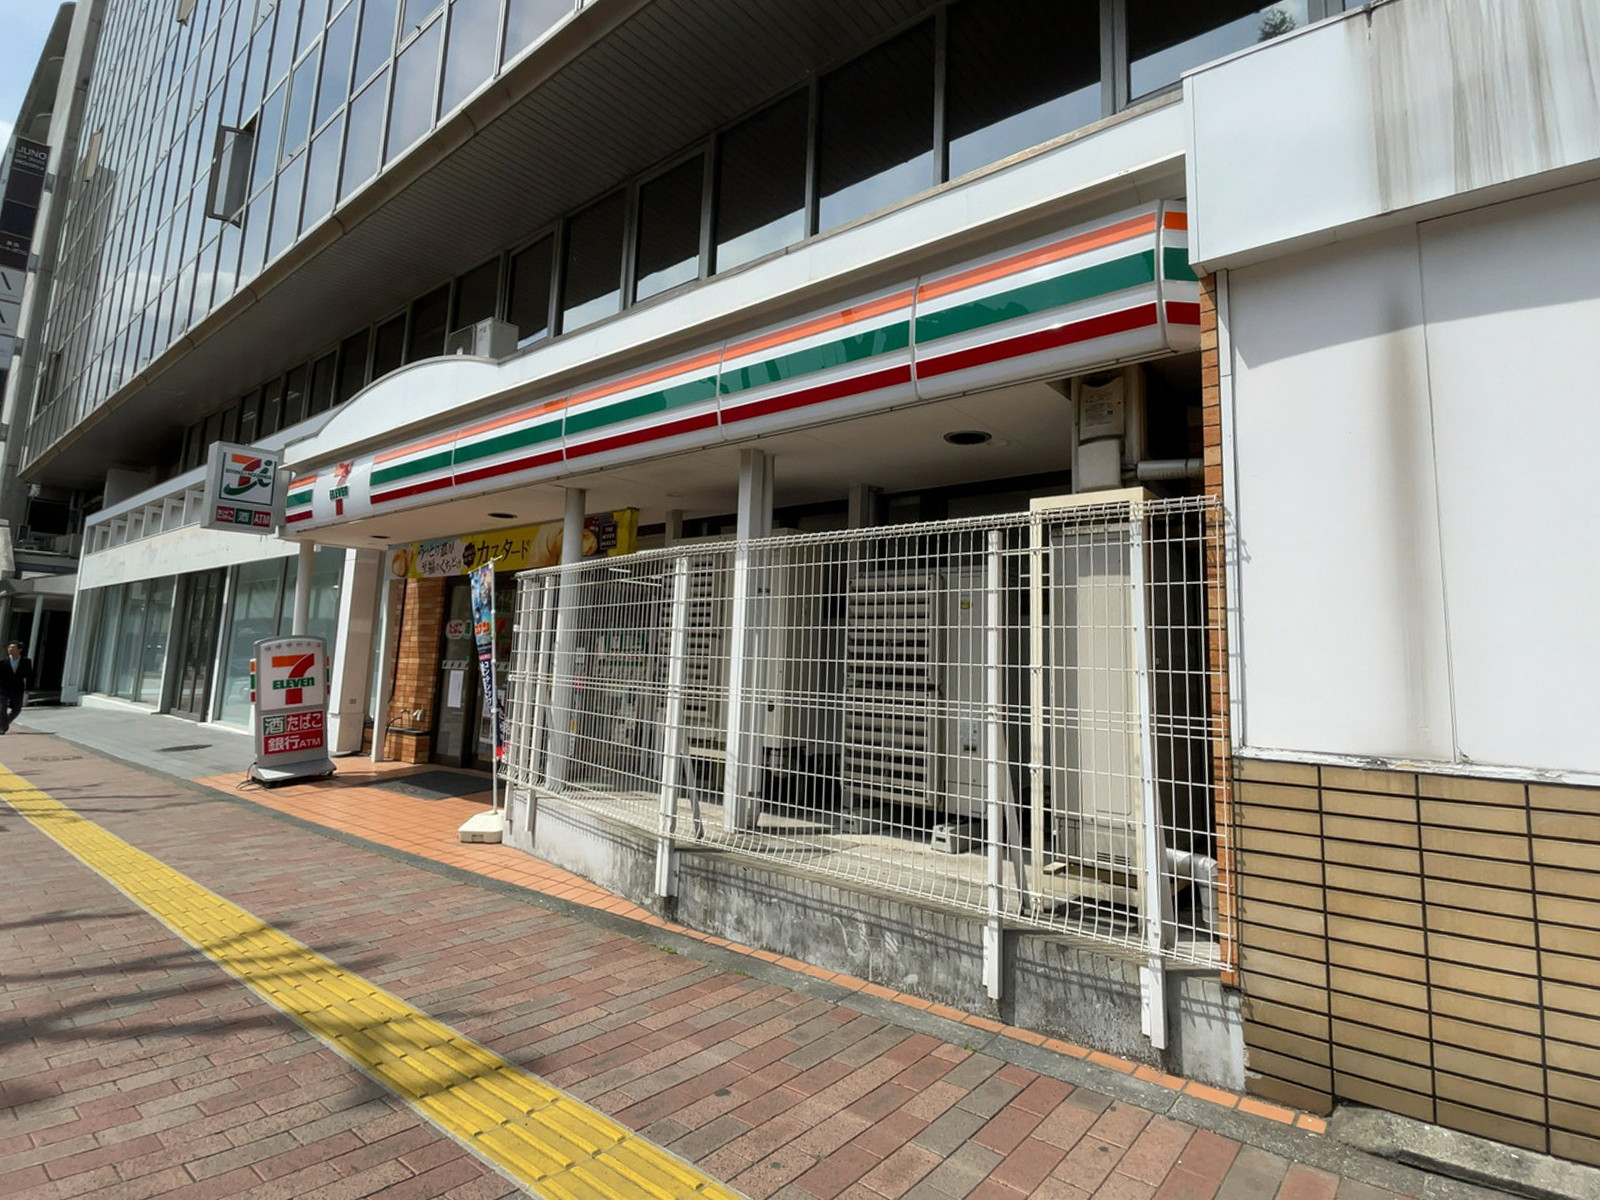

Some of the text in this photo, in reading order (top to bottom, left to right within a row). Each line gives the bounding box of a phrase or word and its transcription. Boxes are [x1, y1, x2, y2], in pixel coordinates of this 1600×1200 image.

[16, 146, 47, 160] JUNO
[254, 514, 270, 524] ATM
[477, 538, 531, 565] カスタード
[265, 713, 322, 735] 酒 たばこ
